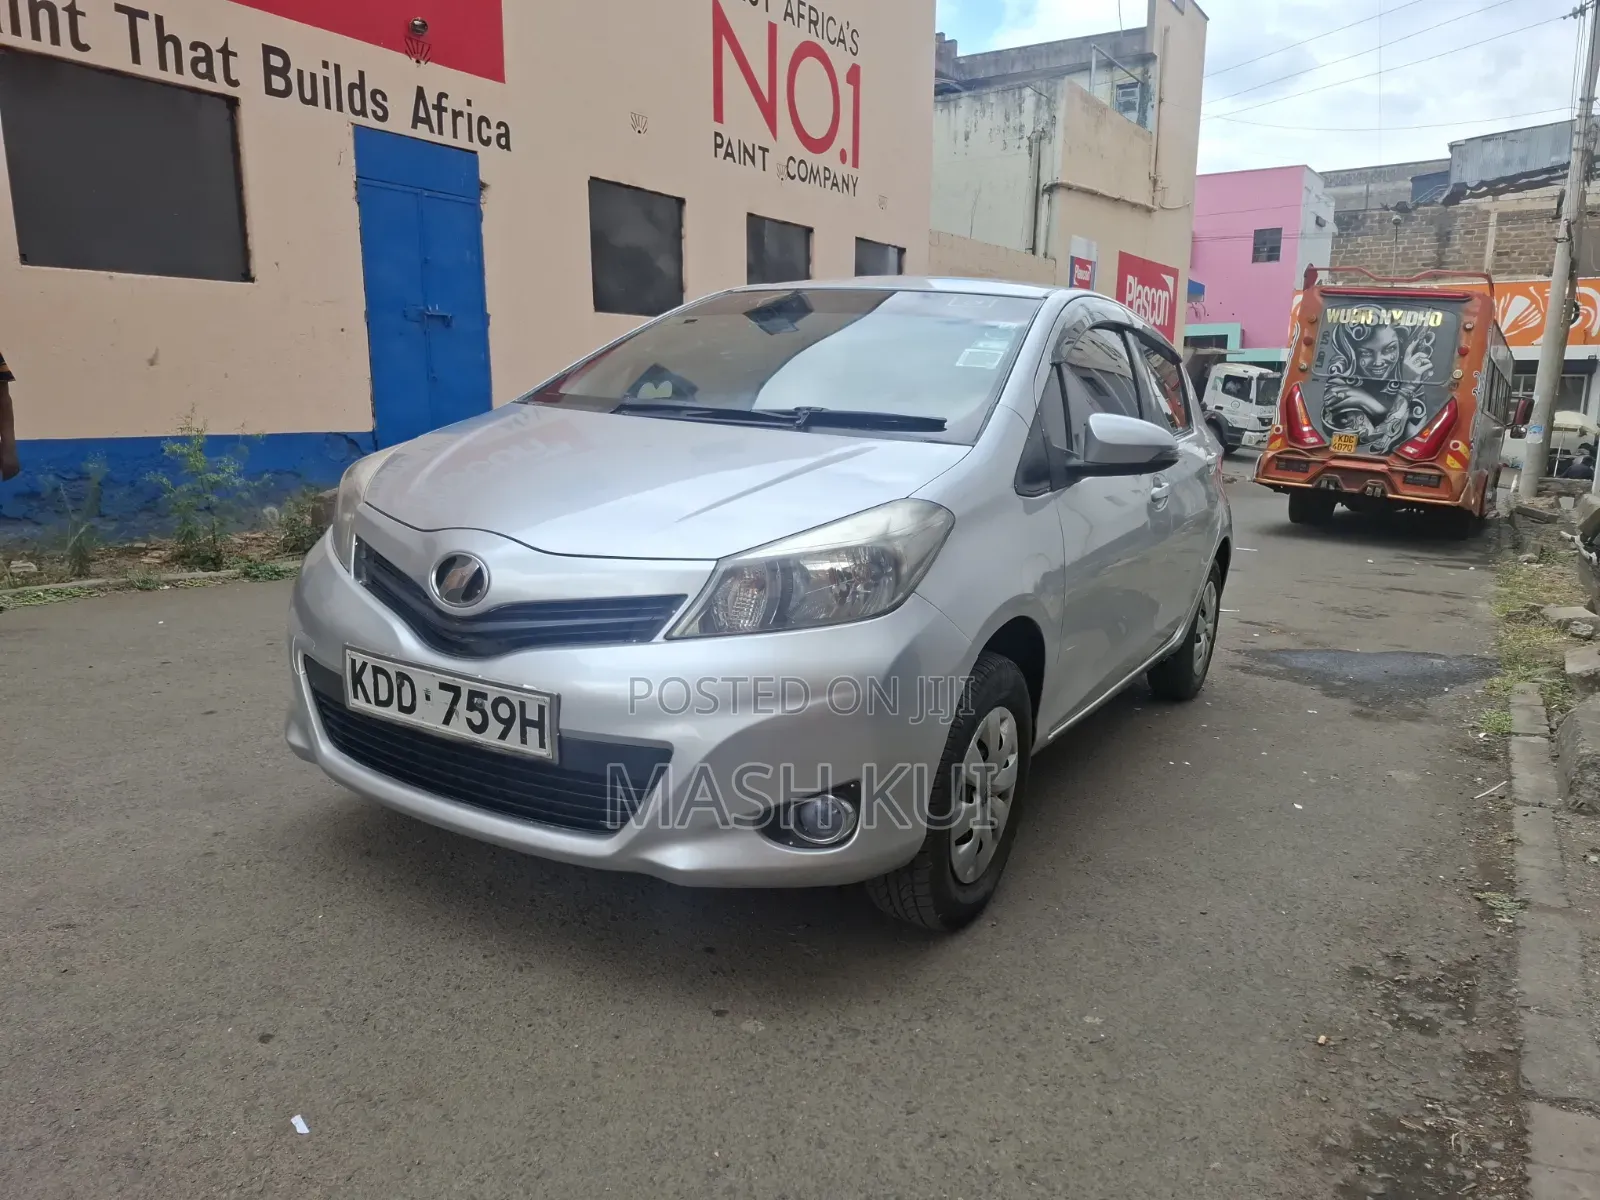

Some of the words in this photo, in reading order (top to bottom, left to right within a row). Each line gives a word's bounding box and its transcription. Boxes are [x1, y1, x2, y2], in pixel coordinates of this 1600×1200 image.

[783, 0, 859, 56] AFRICA'S
[0, 0, 91, 52] int
[114, 3, 240, 88] That
[262, 43, 389, 123] Builds
[411, 85, 512, 152] Africa
[712, 0, 861, 169] NO.1
[714, 131, 770, 172] PAINT
[786, 156, 859, 197] COMPANY
[1125, 274, 1169, 326] Plascon
[350, 657, 417, 715] KDD
[438, 681, 547, 749] 759H
